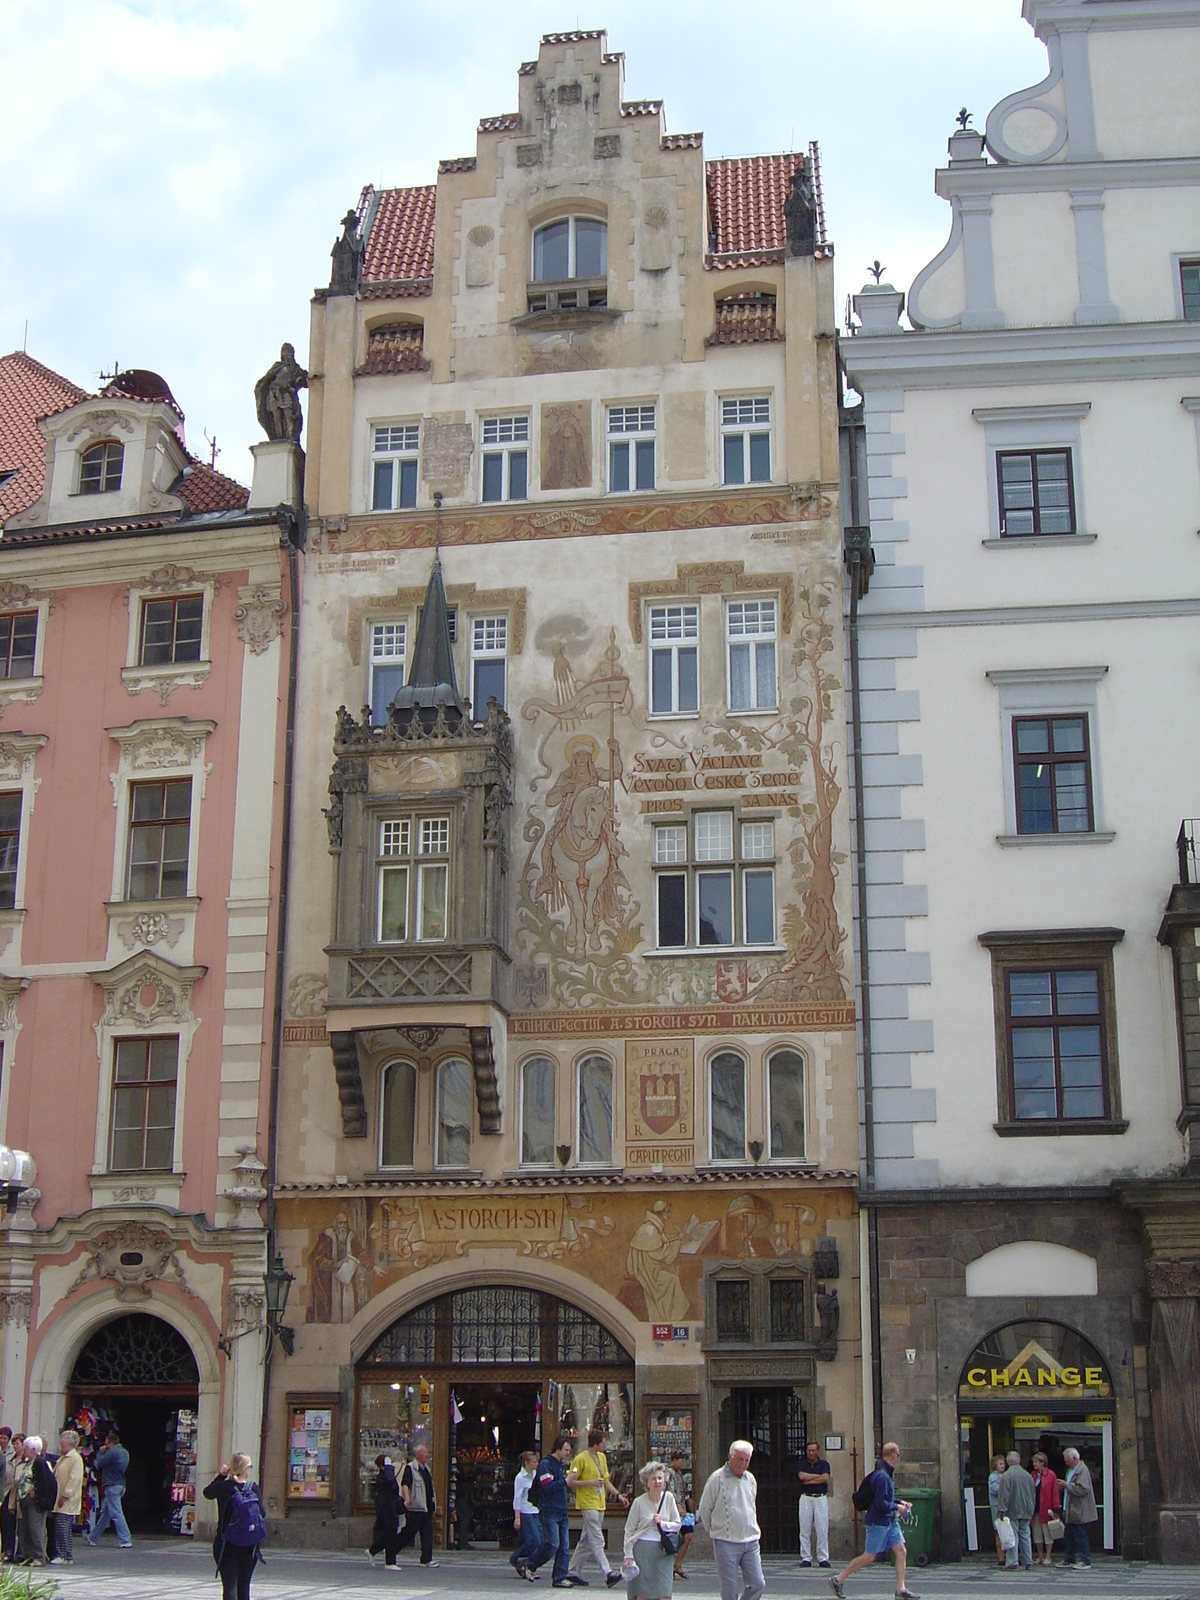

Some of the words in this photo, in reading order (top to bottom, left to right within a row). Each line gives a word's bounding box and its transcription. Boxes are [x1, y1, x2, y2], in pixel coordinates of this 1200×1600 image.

[646, 799, 682, 813] PROS
[644, 1047, 680, 1057] PRAGA
[656, 1327, 669, 1335] 552
[677, 1328, 685, 1336] 16
[967, 1367, 1103, 1387] CHANGE
